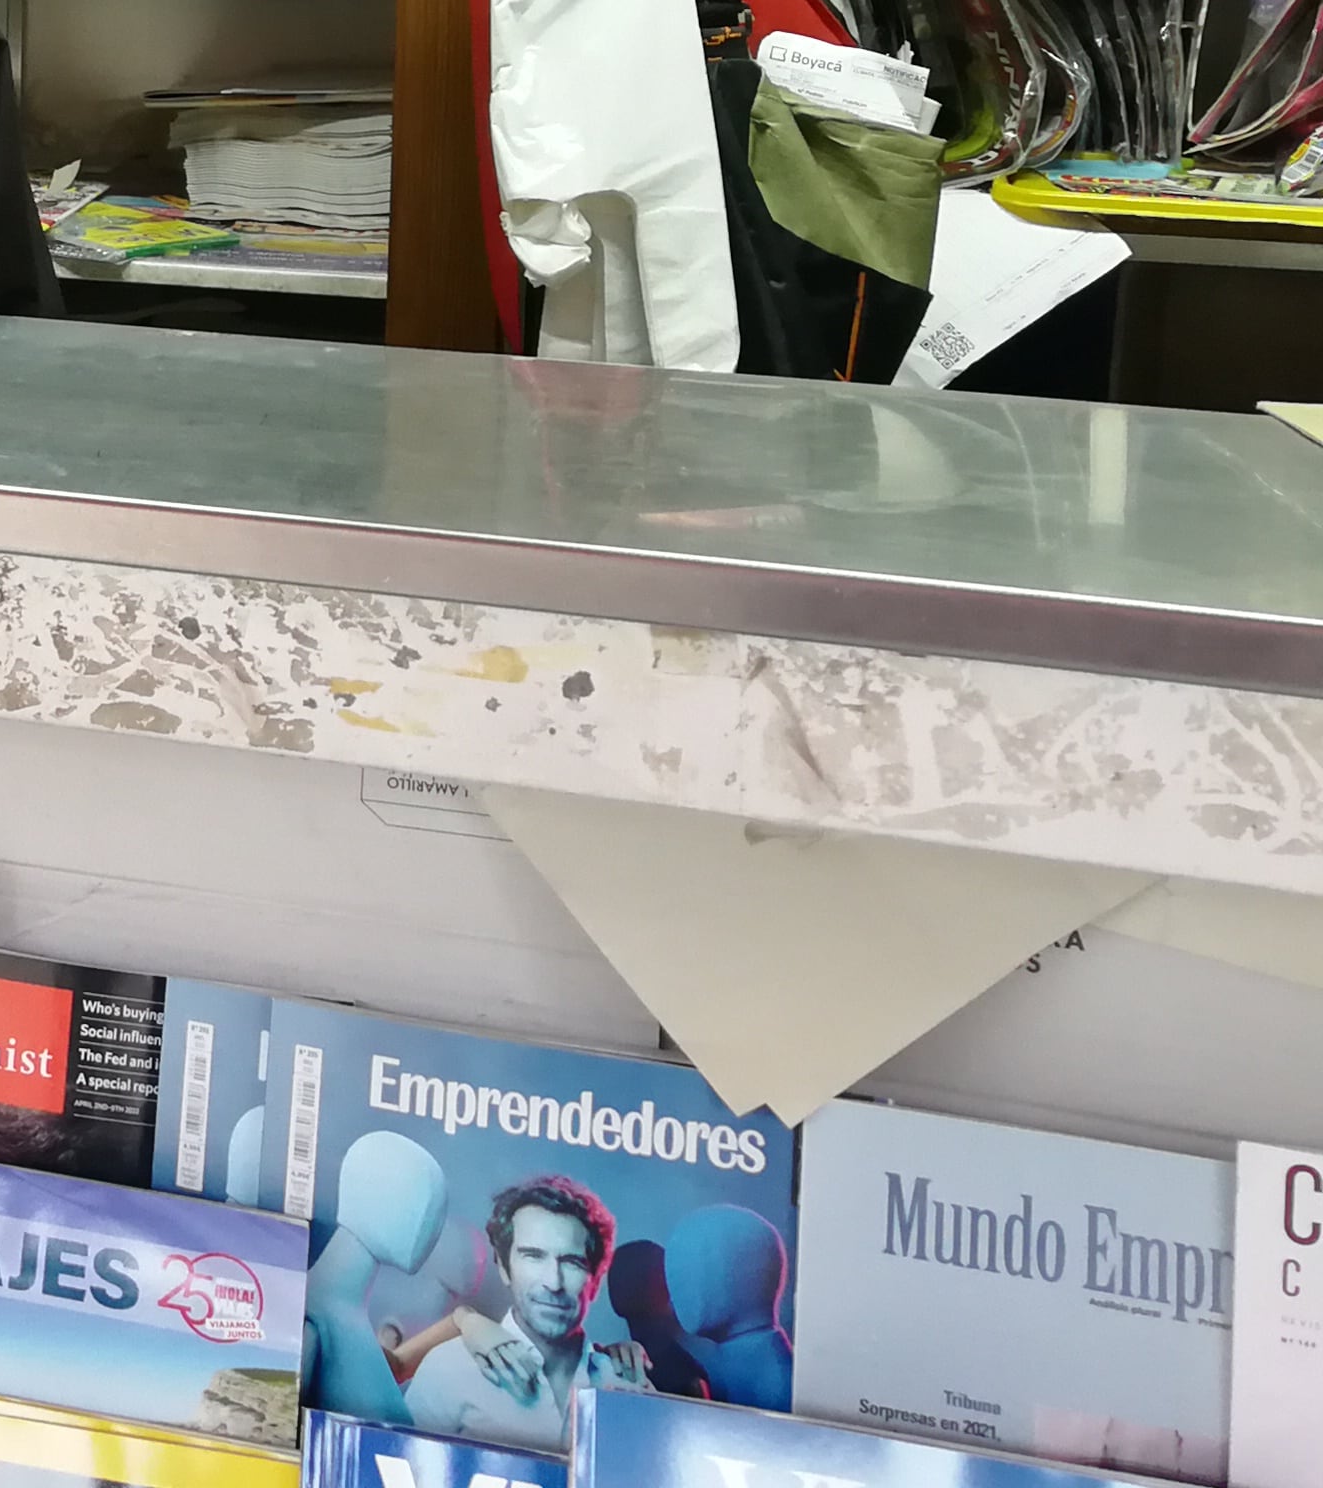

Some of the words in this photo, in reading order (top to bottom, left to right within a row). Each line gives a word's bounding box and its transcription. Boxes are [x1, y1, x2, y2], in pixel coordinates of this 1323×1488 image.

[791, 51, 843, 74] Boyacá
[78, 1048, 103, 1063] The
[104, 1051, 128, 1067] Fed
[129, 1053, 154, 1070] and
[368, 1053, 767, 1175] Emprendedores
[884, 1171, 1066, 1284] Mundo
[209, 1320, 258, 1333] VIAJAMOS
[227, 1329, 263, 1342] JUNTOS
[943, 1389, 1001, 1416] Tribuna
[859, 1397, 937, 1429] Sorpresas
[941, 1416, 959, 1431] en
[962, 1419, 1002, 1443] 2021.
